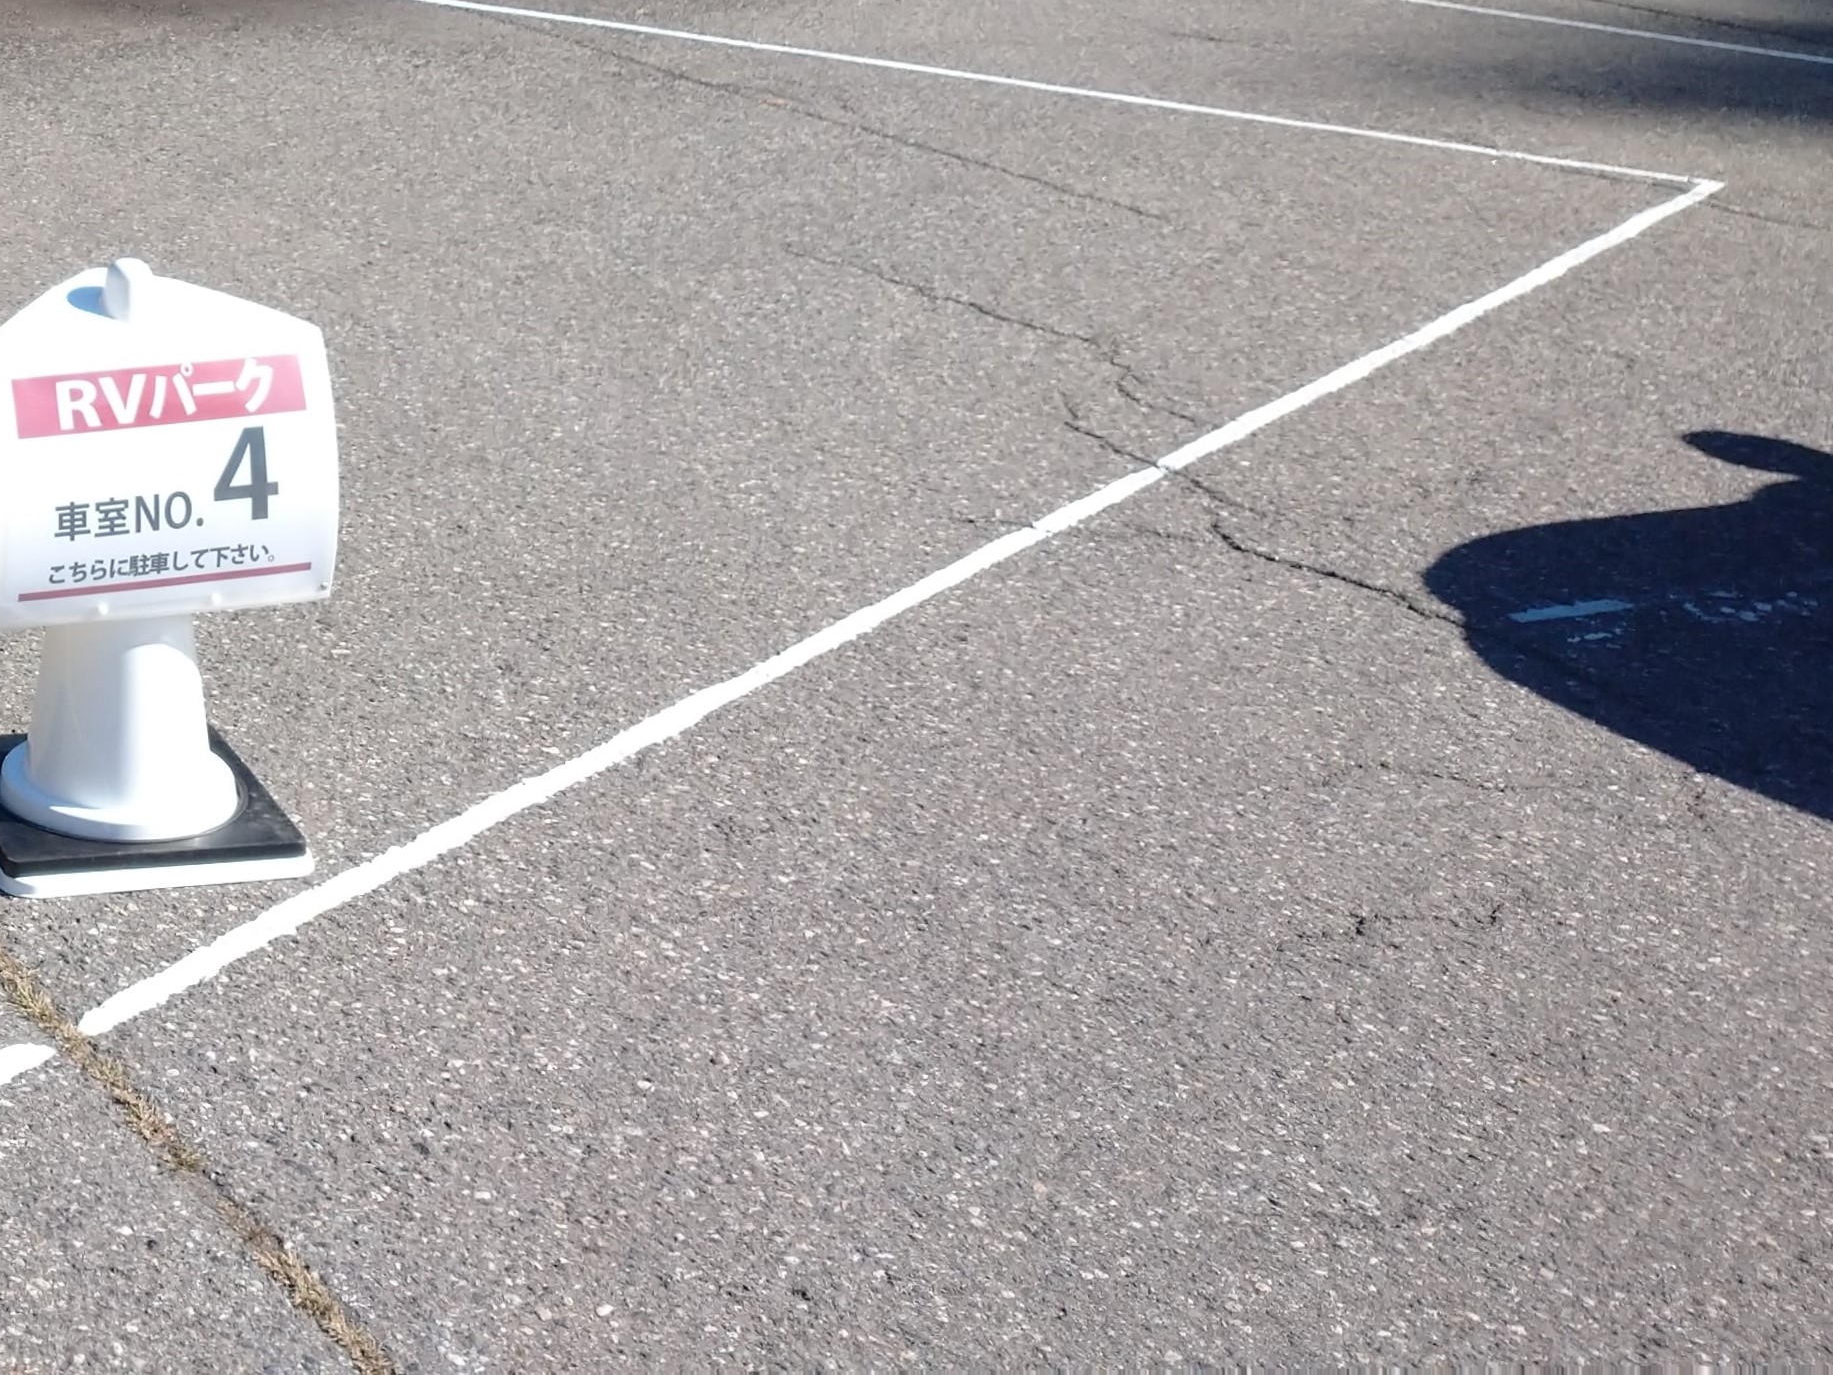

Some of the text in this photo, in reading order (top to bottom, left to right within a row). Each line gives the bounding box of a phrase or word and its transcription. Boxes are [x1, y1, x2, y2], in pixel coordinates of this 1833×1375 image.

[55, 358, 273, 430] RVパーク
[54, 426, 279, 541] 車室NO. 4
[48, 543, 275, 585] こちらに駐車して下さい。
